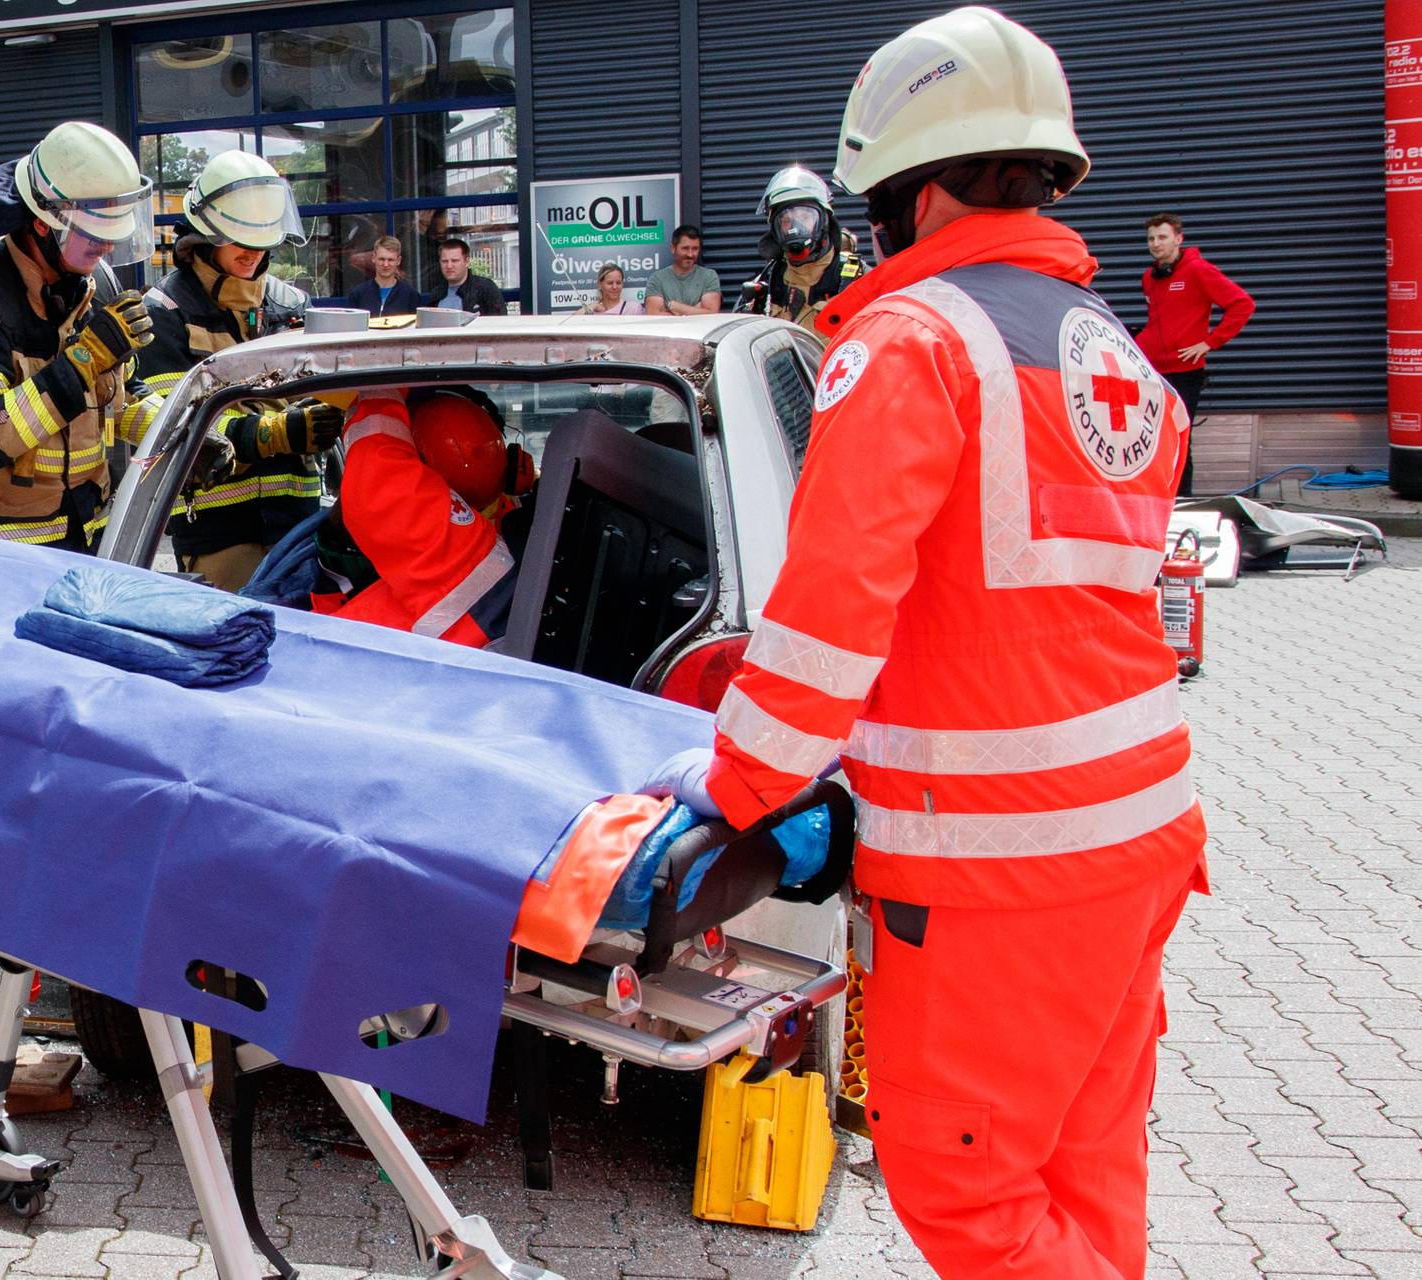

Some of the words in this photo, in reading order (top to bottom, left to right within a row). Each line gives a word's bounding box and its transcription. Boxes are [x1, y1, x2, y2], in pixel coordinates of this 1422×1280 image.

[551, 237, 570, 245] DER
[571, 234, 604, 243] GRÜNE
[605, 232, 660, 242] ÖLWECHSEL
[1070, 319, 1151, 380] DEUTSCHES
[1073, 392, 1116, 466] ROTES
[1122, 399, 1159, 467] KREUZ
